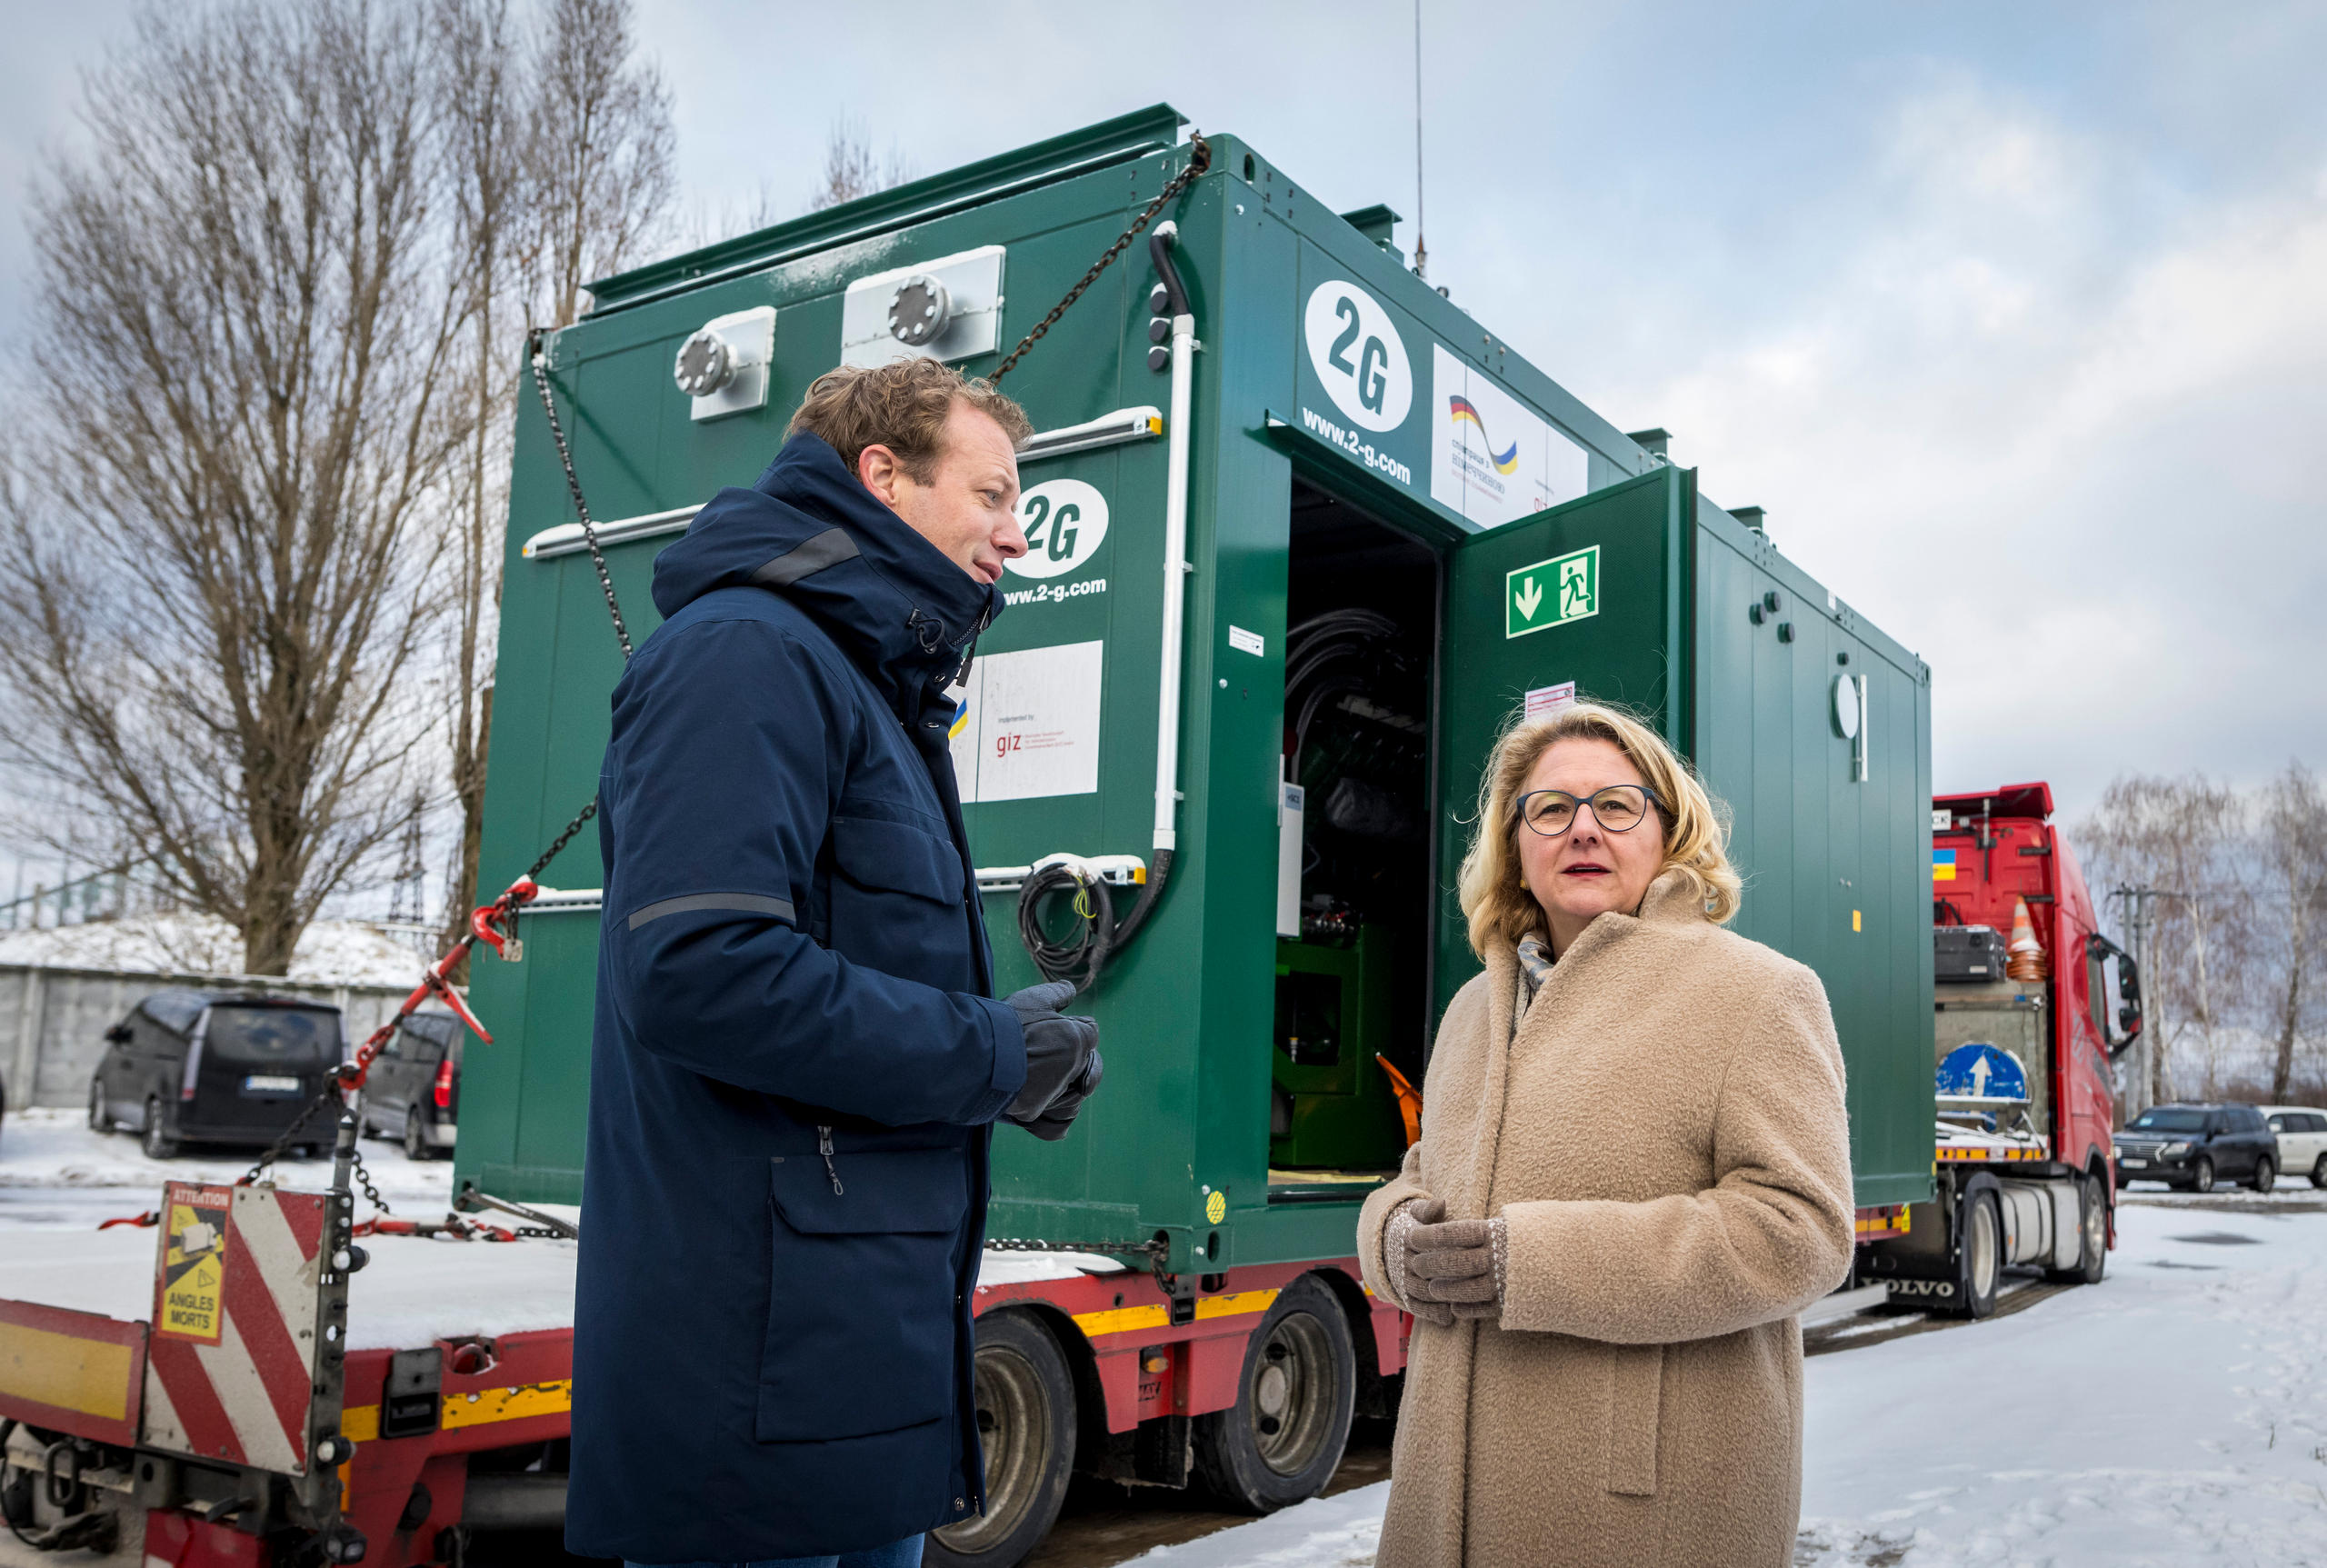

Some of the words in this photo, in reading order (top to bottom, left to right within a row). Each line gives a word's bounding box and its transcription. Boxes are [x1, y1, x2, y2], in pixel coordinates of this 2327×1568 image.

[1329, 295, 1388, 415] 2G
[1303, 406, 1411, 485] www.2-g.com
[1024, 494, 1081, 563] 2G
[1004, 578, 1107, 606] ww.2-g.com
[997, 732, 1021, 758] giz
[173, 1188, 228, 1207] ATTENTION
[168, 1292, 215, 1313] ANGLES
[171, 1309, 210, 1330] MORTS
